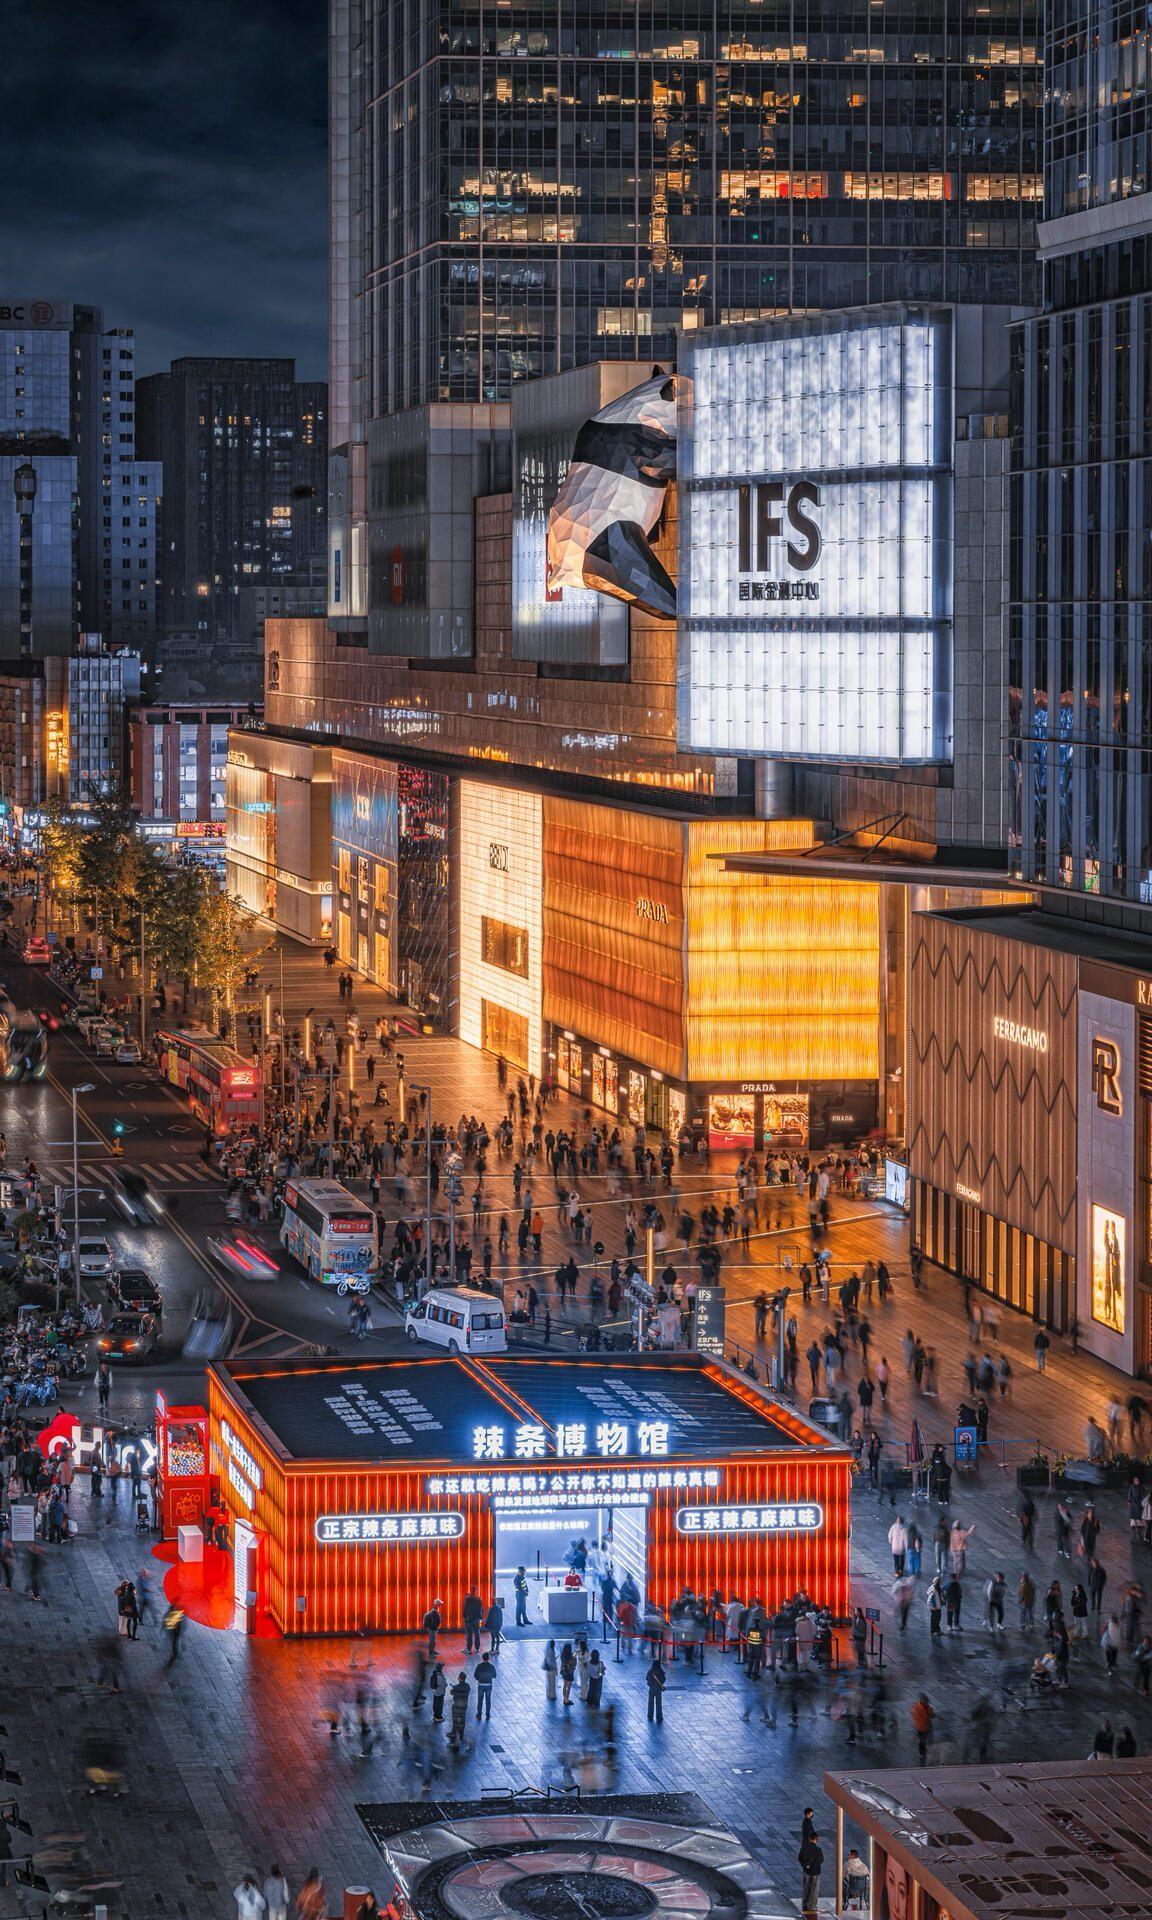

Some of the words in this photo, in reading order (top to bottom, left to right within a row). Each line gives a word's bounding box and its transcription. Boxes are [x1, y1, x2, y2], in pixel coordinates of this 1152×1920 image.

[739, 481, 822, 572] IFS
[636, 897, 669, 925] PRADA
[993, 1016, 1048, 1053] FERRAGAMO
[741, 1083, 777, 1093] PRADA
[698, 1290, 711, 1299] IFS
[473, 1421, 669, 1459] 辣条博物馆
[322, 1517, 458, 1539] 正宗辣条麻辣味
[684, 1508, 816, 1529] 正宗辣条麻辣味
